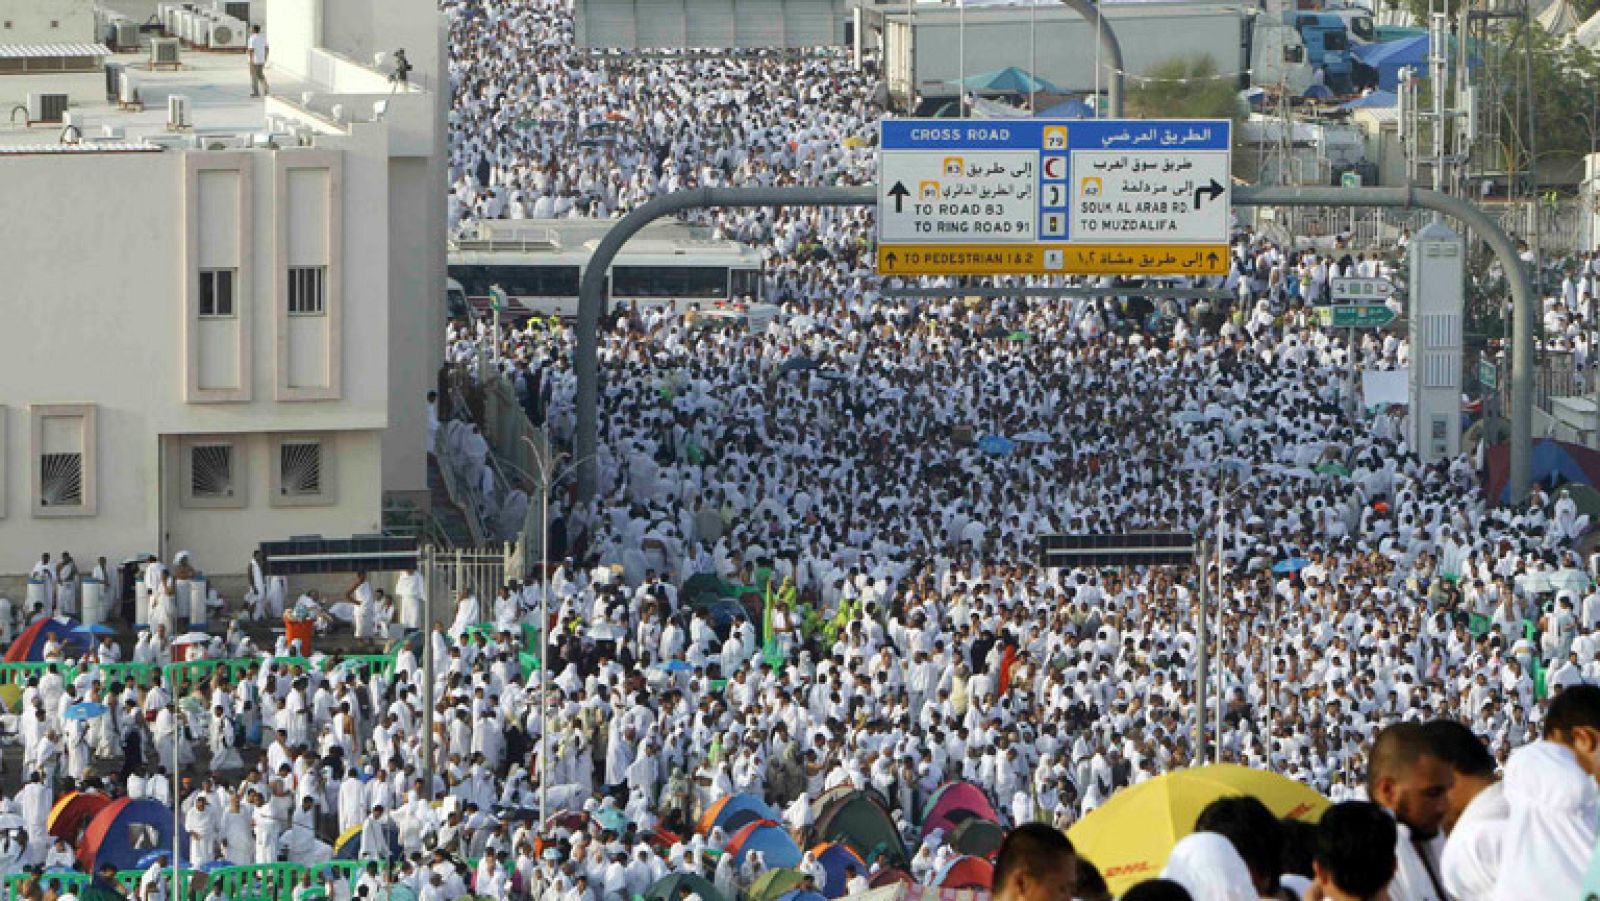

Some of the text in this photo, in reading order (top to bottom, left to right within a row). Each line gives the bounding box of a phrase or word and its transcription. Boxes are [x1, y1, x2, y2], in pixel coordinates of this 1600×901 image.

[910, 128, 1011, 141] CROSS ROAD
[1101, 128, 1212, 148] الطريق العرضي
[1048, 137, 1063, 147] 79
[966, 161, 1006, 178] طريق
[1093, 156, 1128, 172] العرب
[1162, 157, 1193, 173] طريق
[979, 183, 1015, 199] الطريق
[914, 203, 1005, 216] TO ROAD 83
[1116, 201, 1132, 214] AL
[1135, 201, 1167, 214] ARAB
[914, 220, 1030, 233] TO RING ROAD 91
[1081, 219, 1178, 231] TO MUZDALIFA
[904, 252, 920, 264] TO
[924, 252, 1003, 264] PEDESTRIAN
[1138, 251, 1177, 268] طريق
